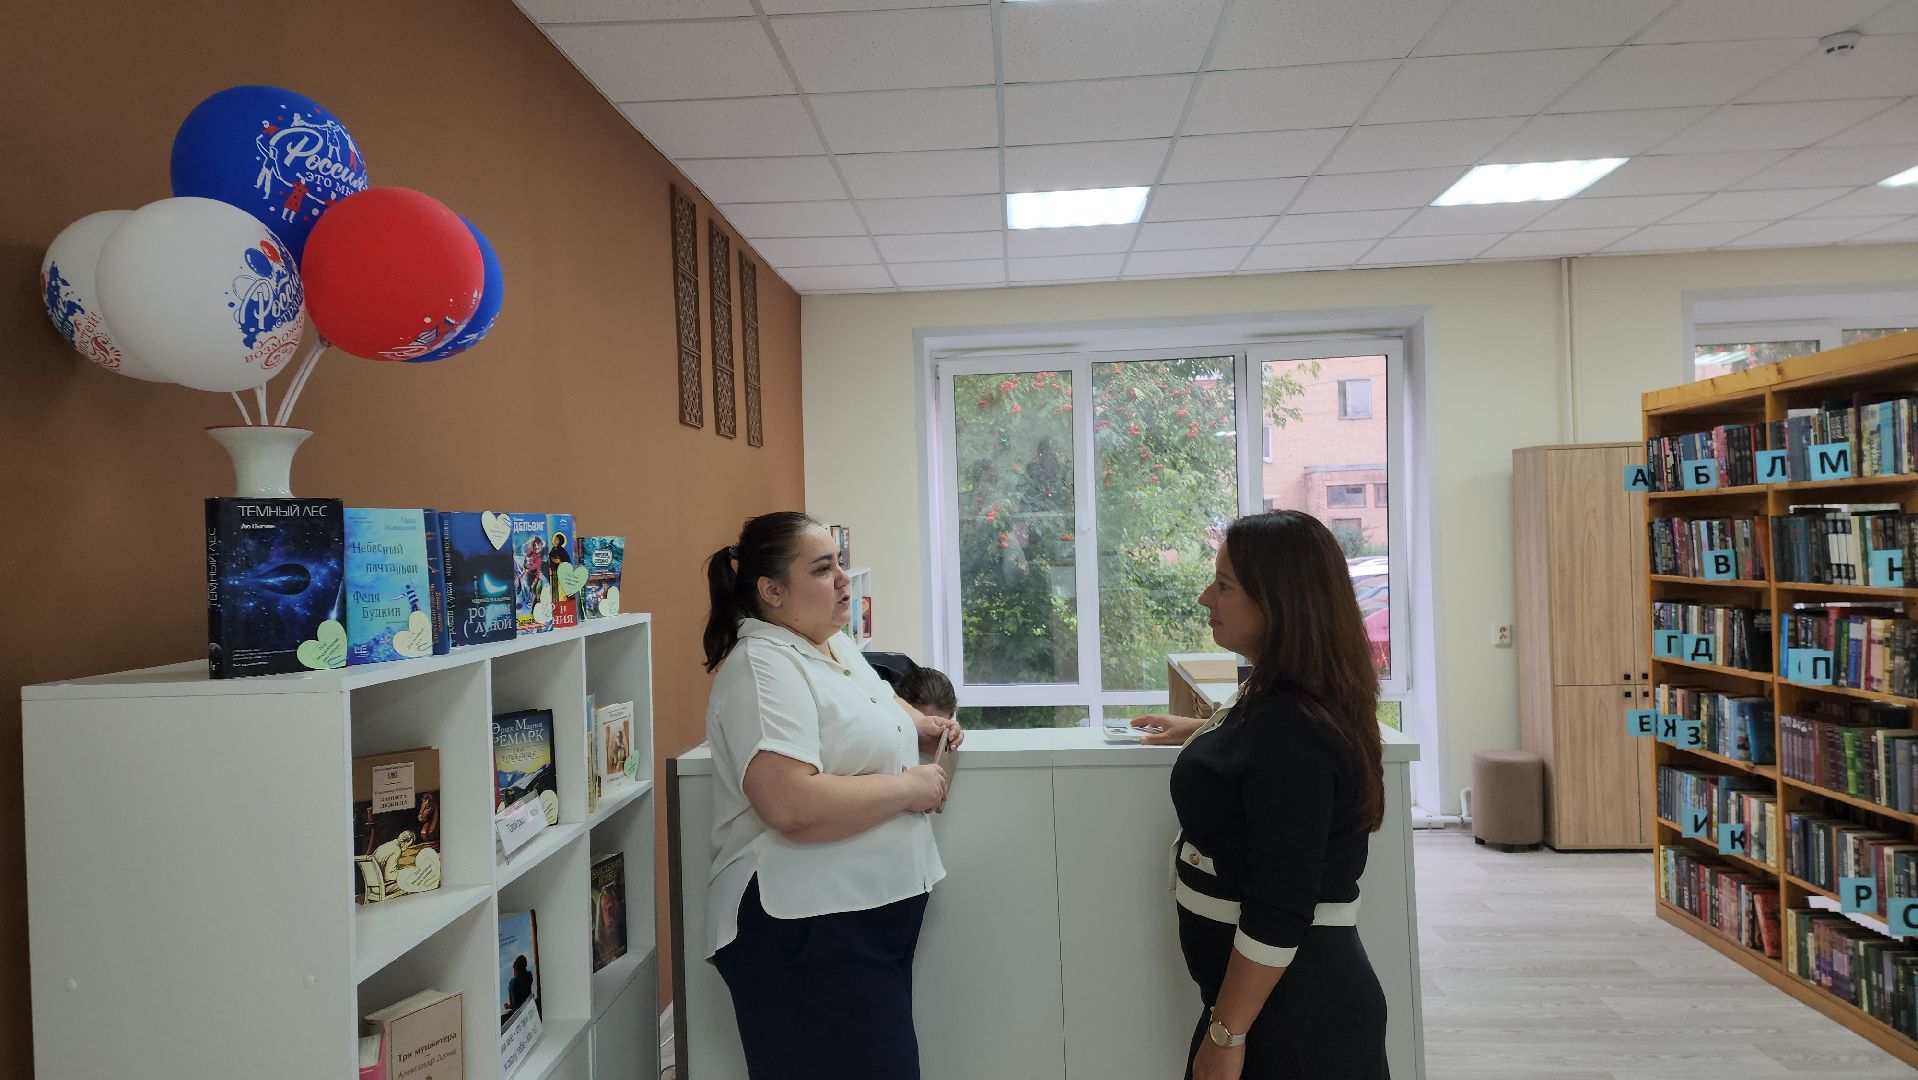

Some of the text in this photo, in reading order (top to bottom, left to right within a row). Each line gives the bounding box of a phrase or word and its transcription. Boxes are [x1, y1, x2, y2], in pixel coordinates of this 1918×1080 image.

[1766, 456, 1787, 477] Л
[1819, 450, 1849, 474] М
[1632, 468, 1648, 486] А
[1694, 465, 1710, 484] Б
[237, 504, 328, 517] ТЕМНЫЙ ЛЕС
[352, 541, 403, 555] Небесный
[365, 563, 418, 575] почтальон
[1715, 555, 1731, 574] В
[352, 591, 380, 604] Федя
[362, 607, 401, 621] Булкин
[1667, 635, 1678, 654] Г
[1691, 638, 1713, 661] Д
[1813, 656, 1831, 680] П
[1639, 715, 1652, 732] Е
[1687, 727, 1701, 745] З
[1730, 830, 1745, 850] К
[1856, 885, 1872, 909] Р
[397, 1032, 457, 1063] Три мушкетера
